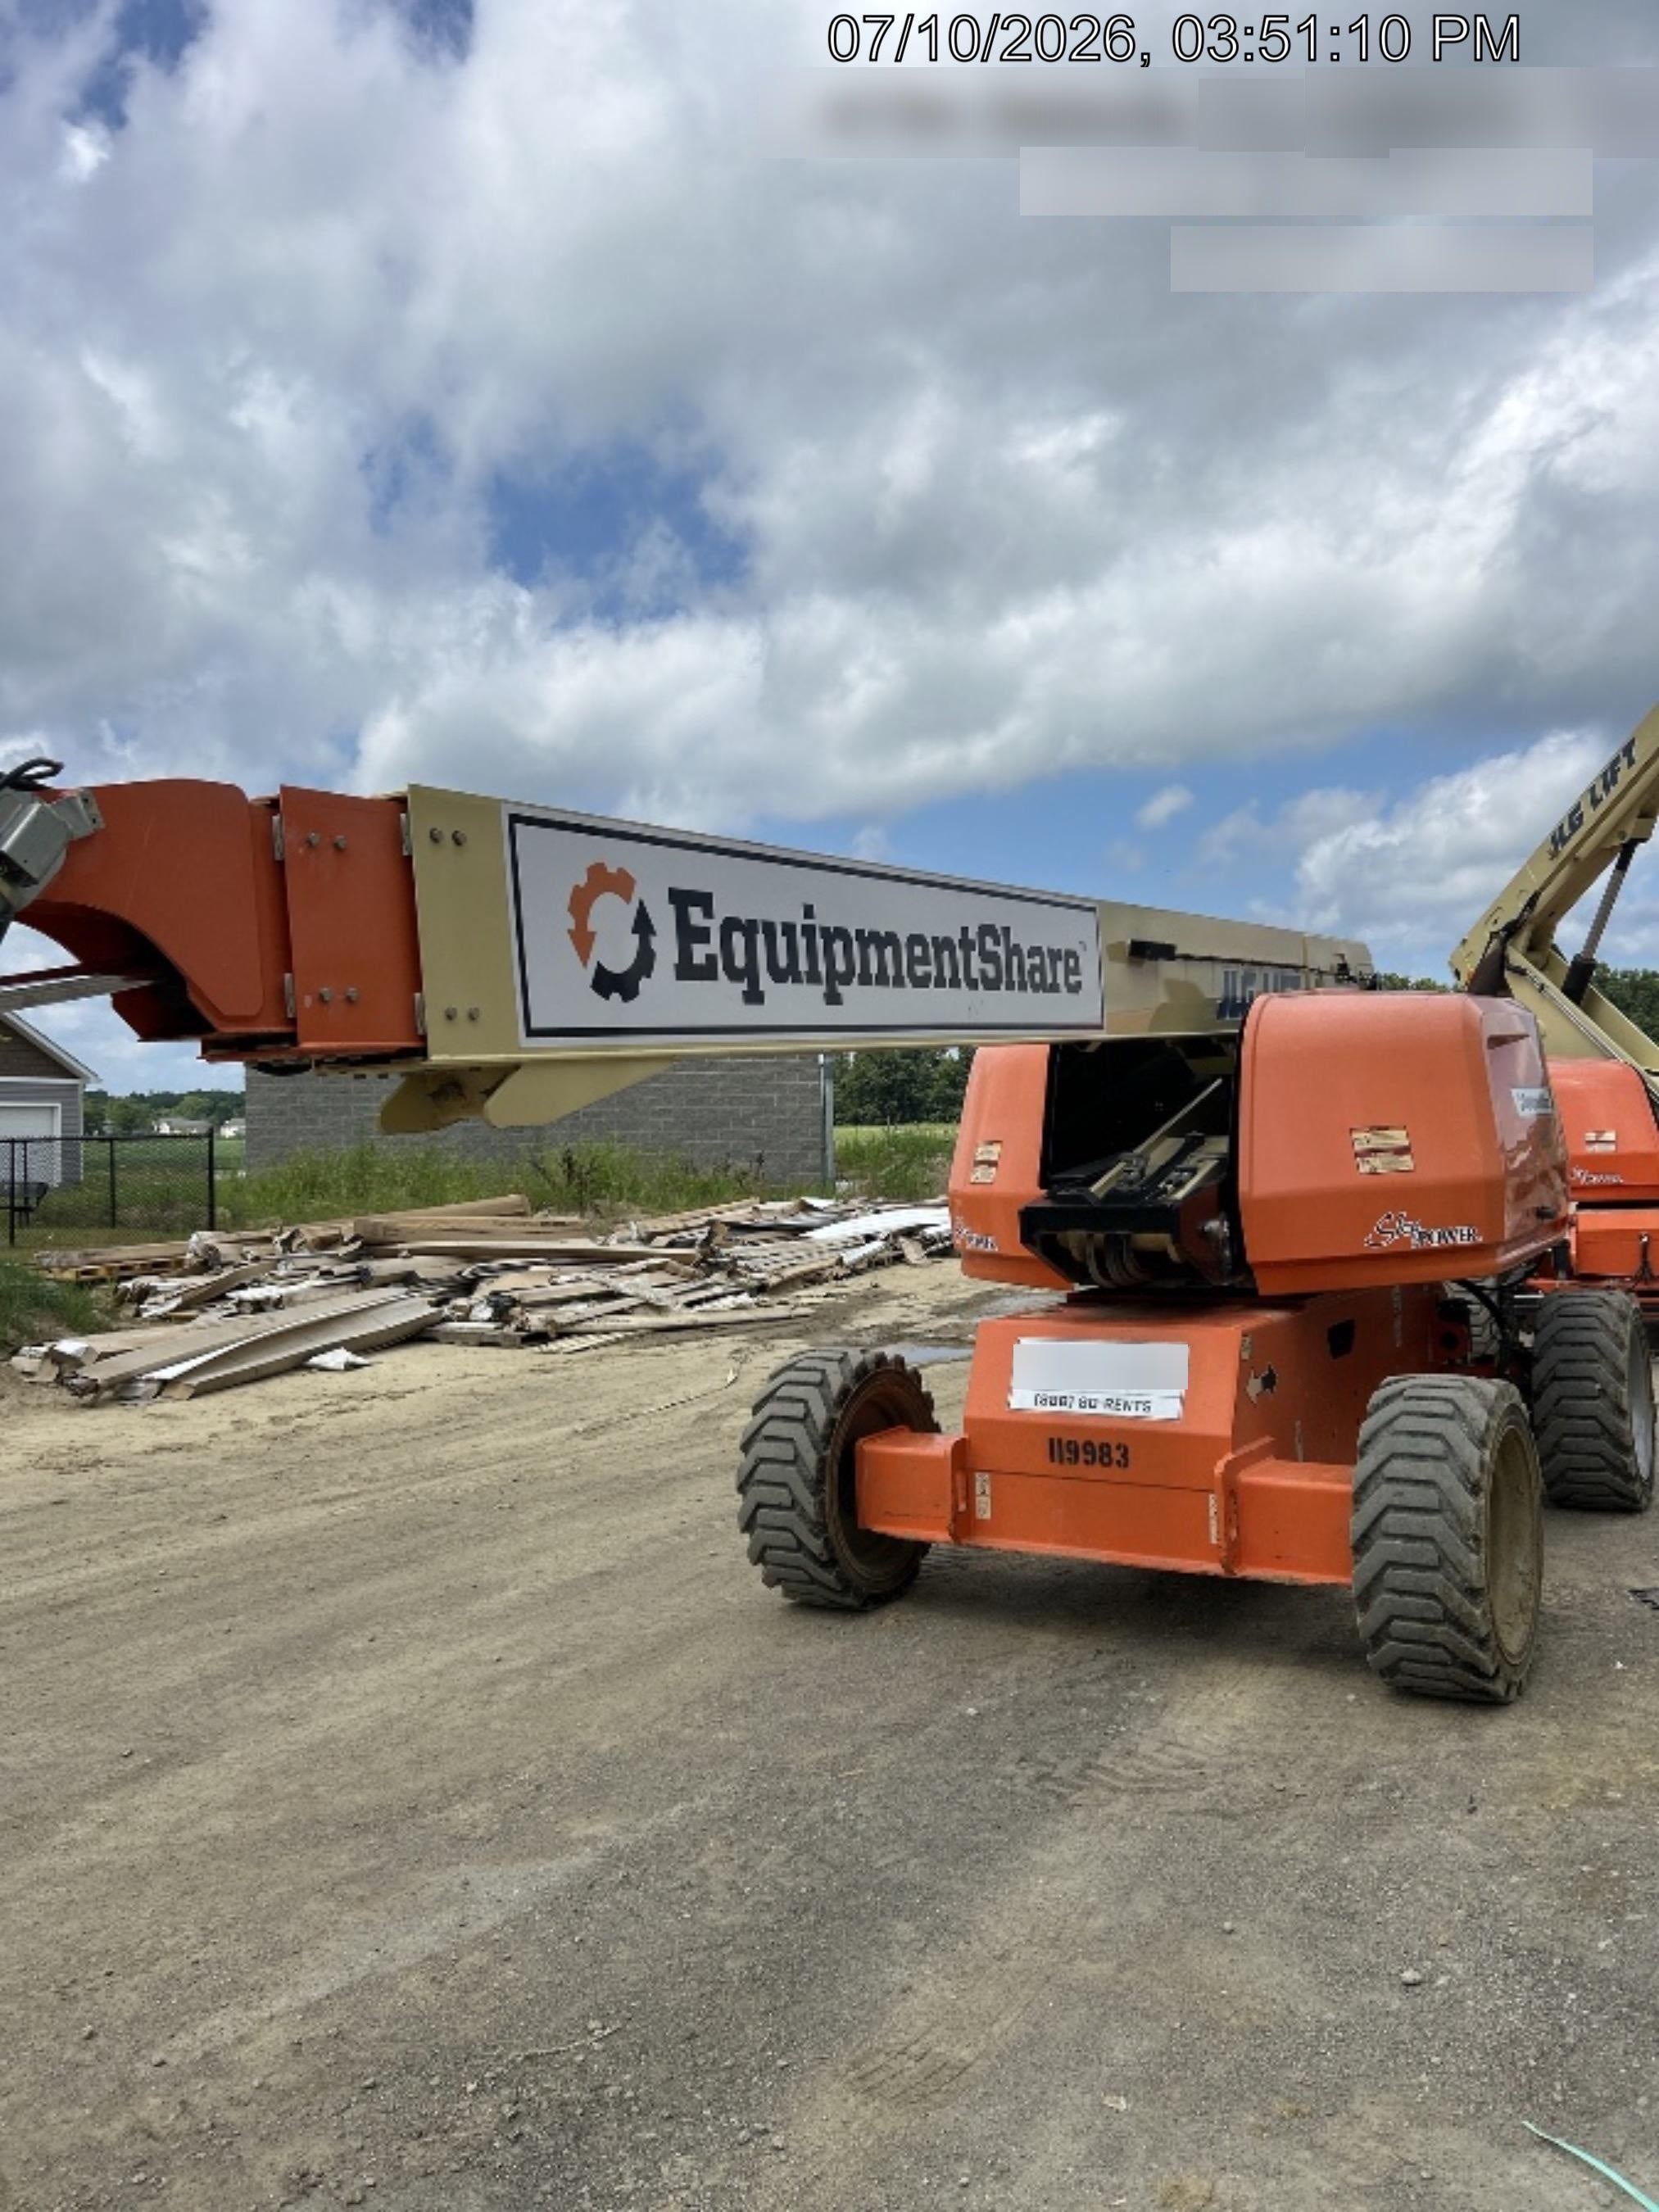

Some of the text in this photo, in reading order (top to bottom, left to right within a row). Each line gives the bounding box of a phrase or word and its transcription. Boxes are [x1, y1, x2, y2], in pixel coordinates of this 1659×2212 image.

[1547, 737, 1635, 860] JLG LIFT
[668, 887, 1082, 1005] EquipmentShare
[1048, 1437, 1130, 1469] 119983
